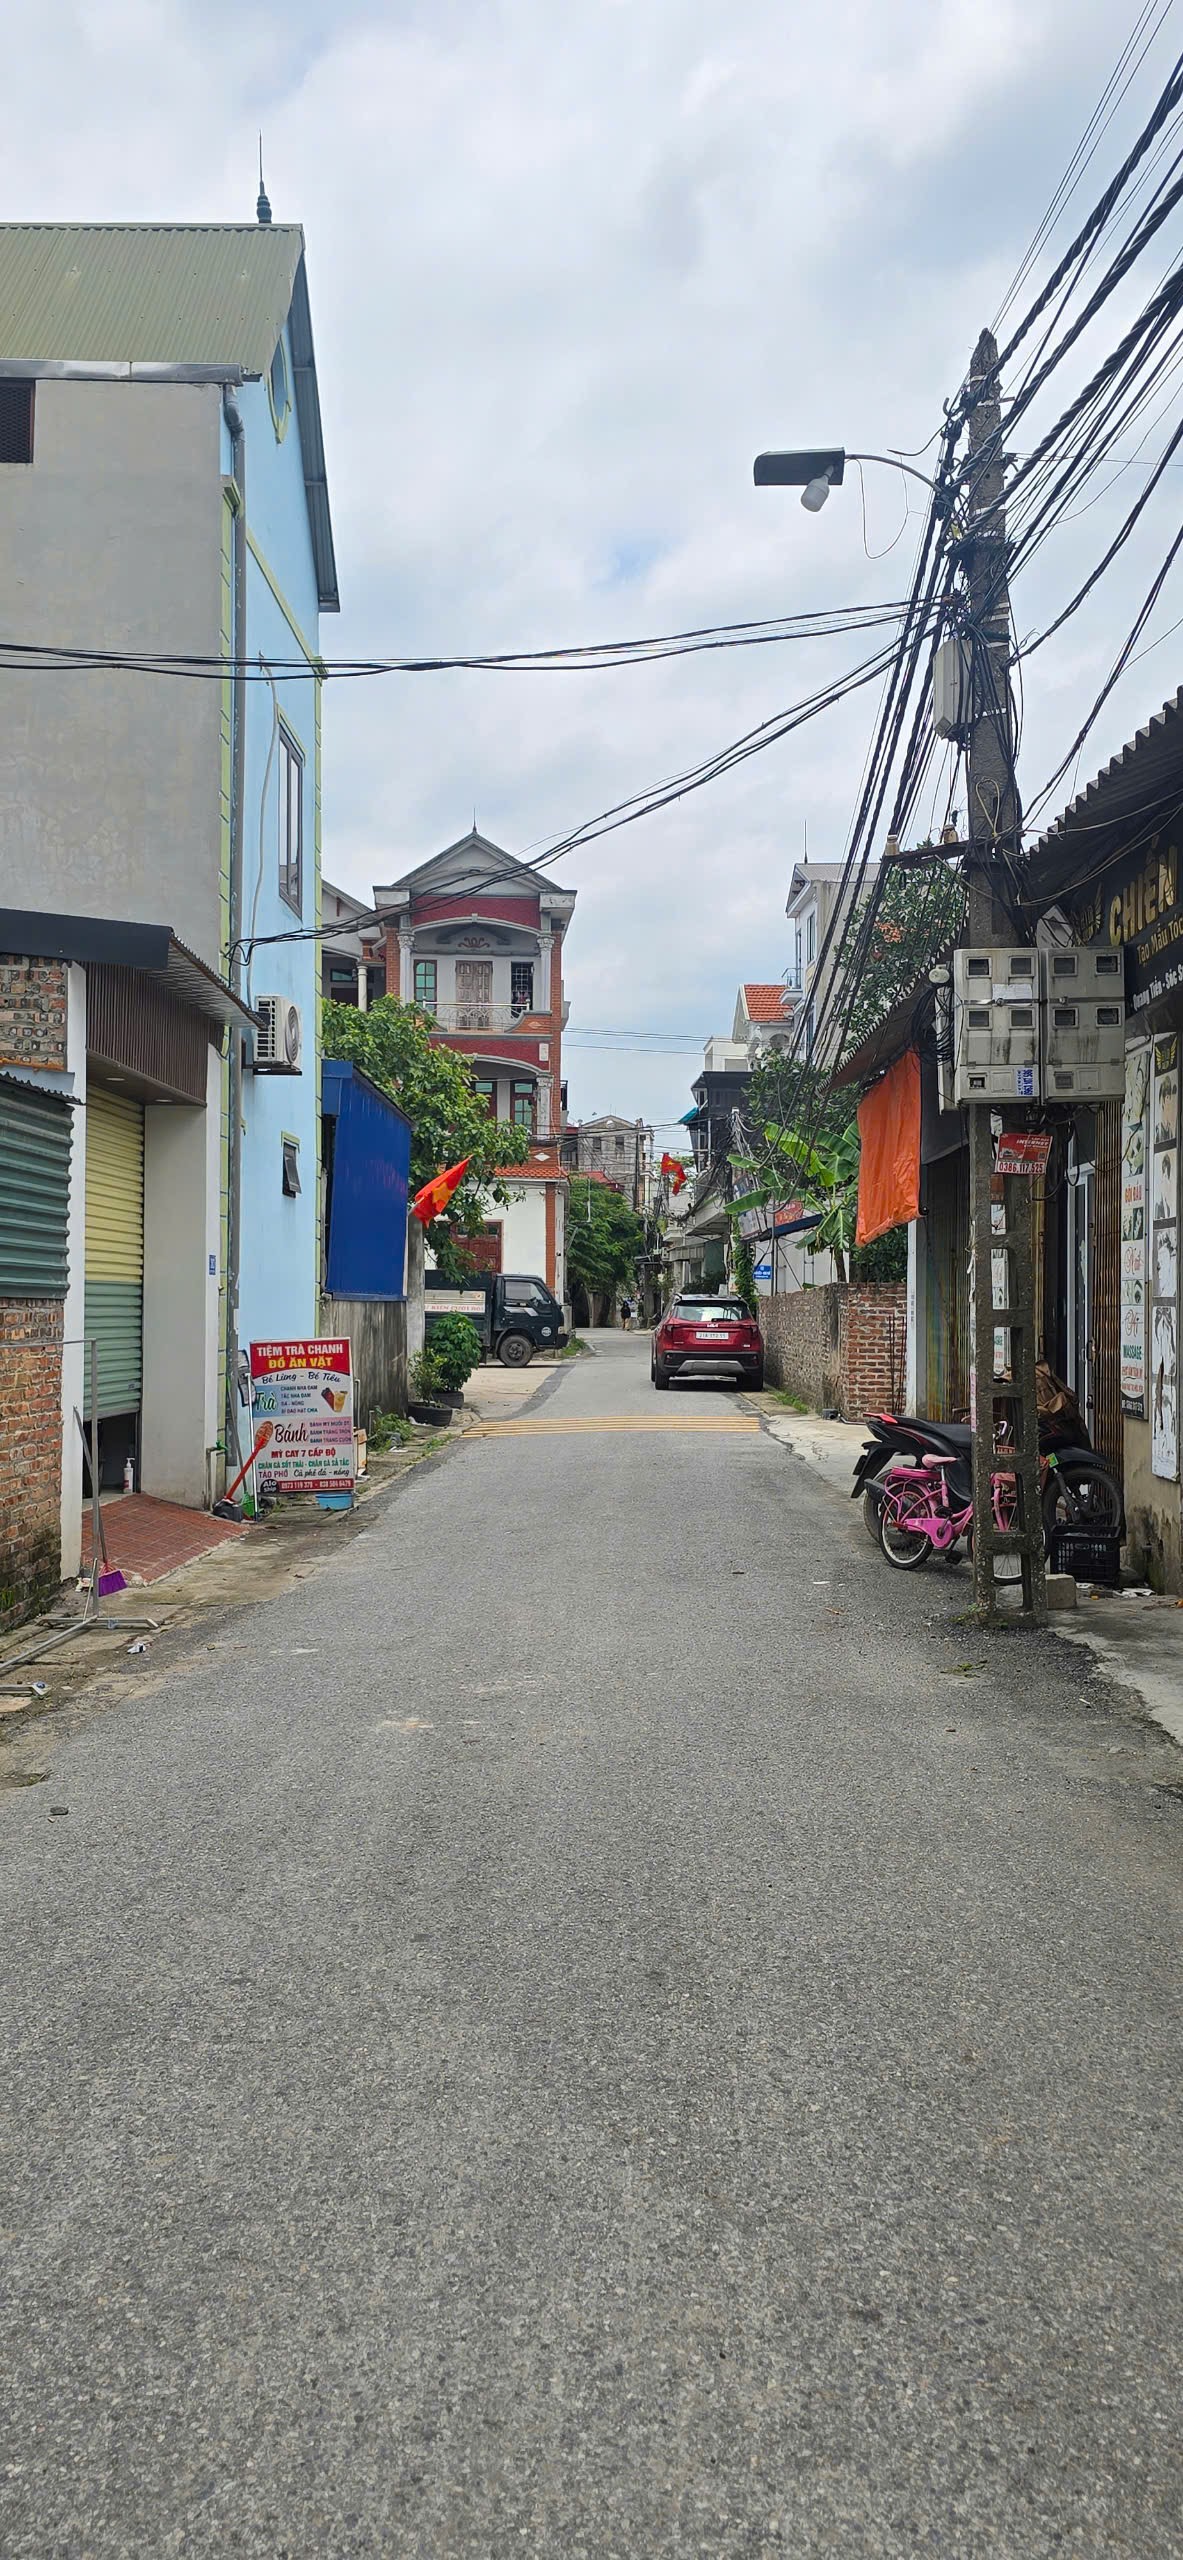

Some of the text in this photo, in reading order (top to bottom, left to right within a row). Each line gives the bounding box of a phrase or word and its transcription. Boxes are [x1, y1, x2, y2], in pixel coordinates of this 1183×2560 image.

[999, 1162, 1044, 1173] 0386.117.525
[257, 1343, 343, 1359] TIỆM TRÀ CHANH
[1123, 1344, 1142, 1360] MASSAGE
[289, 1356, 307, 1368] ĂN
[309, 1355, 333, 1369] VẶT
[256, 1391, 277, 1411] Trà
[274, 1422, 309, 1443] Bánh
[285, 1449, 300, 1458] CAY
[301, 1449, 306, 1457] 7
[308, 1446, 324, 1457] CẤP
[325, 1446, 336, 1458] ĐỘ
[263, 1480, 277, 1488] Alo
